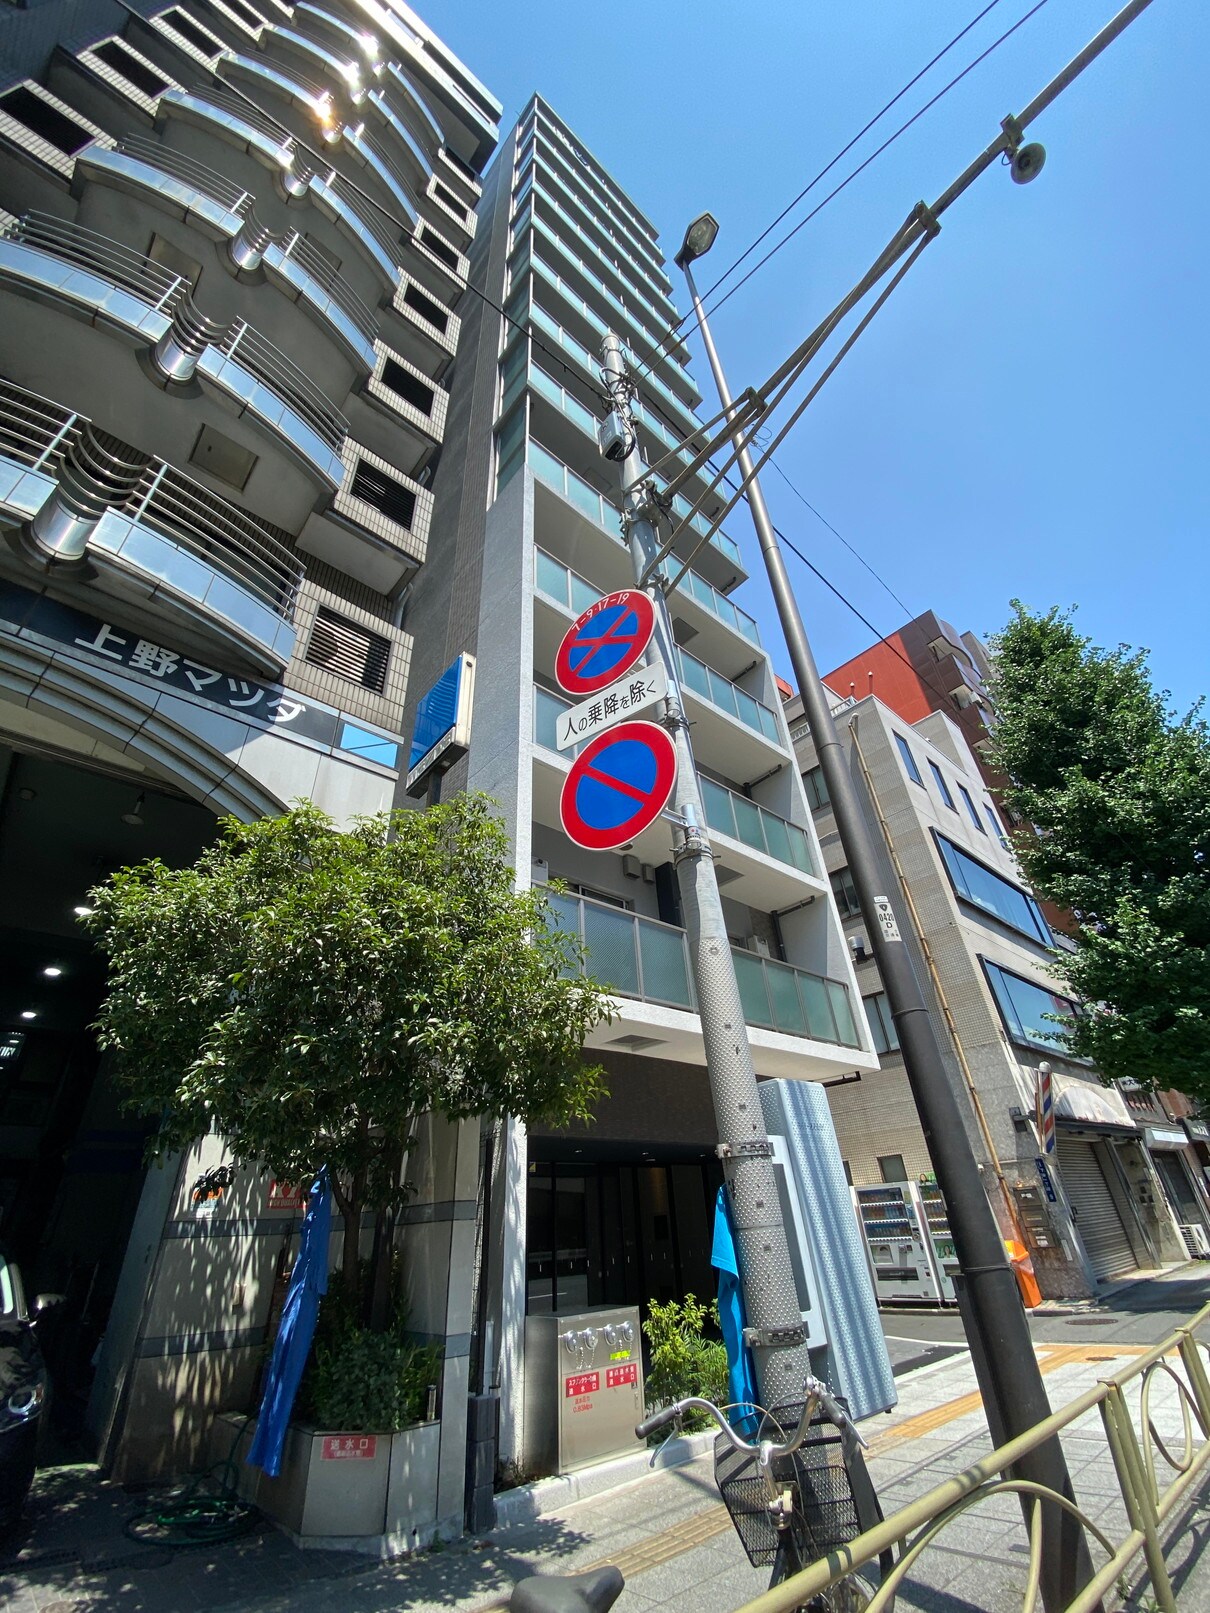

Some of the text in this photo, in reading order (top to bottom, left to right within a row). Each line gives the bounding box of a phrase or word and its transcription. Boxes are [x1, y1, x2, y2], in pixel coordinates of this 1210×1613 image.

[74, 623, 305, 723] 上野マツダ
[563, 680, 657, 741] 人の乗降を除く
[331, 1438, 369, 1450] 送水口
